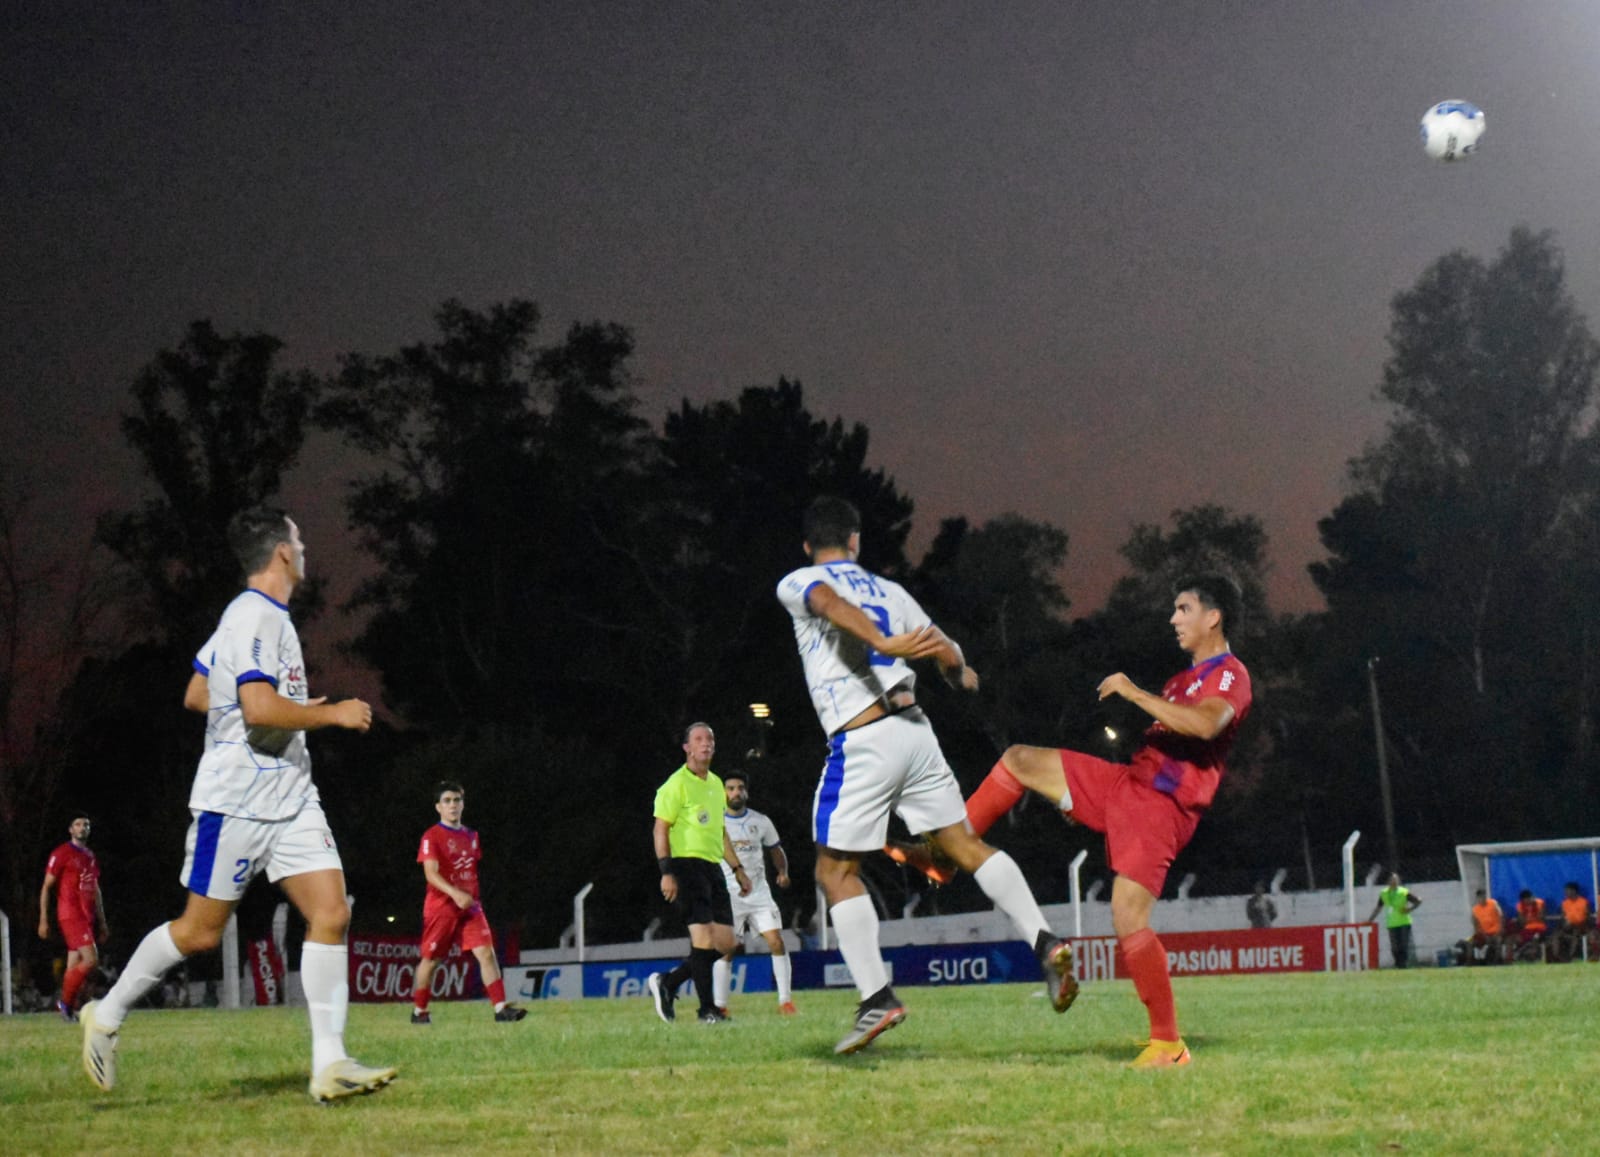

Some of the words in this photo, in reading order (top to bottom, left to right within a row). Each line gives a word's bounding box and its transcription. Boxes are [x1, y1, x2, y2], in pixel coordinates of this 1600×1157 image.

[1071, 938, 1118, 981] FIAT
[1166, 945, 1232, 972] PASIÓN
[1238, 945, 1304, 969] MUEVE
[1323, 925, 1373, 972] FIAT
[928, 957, 988, 982] sura
